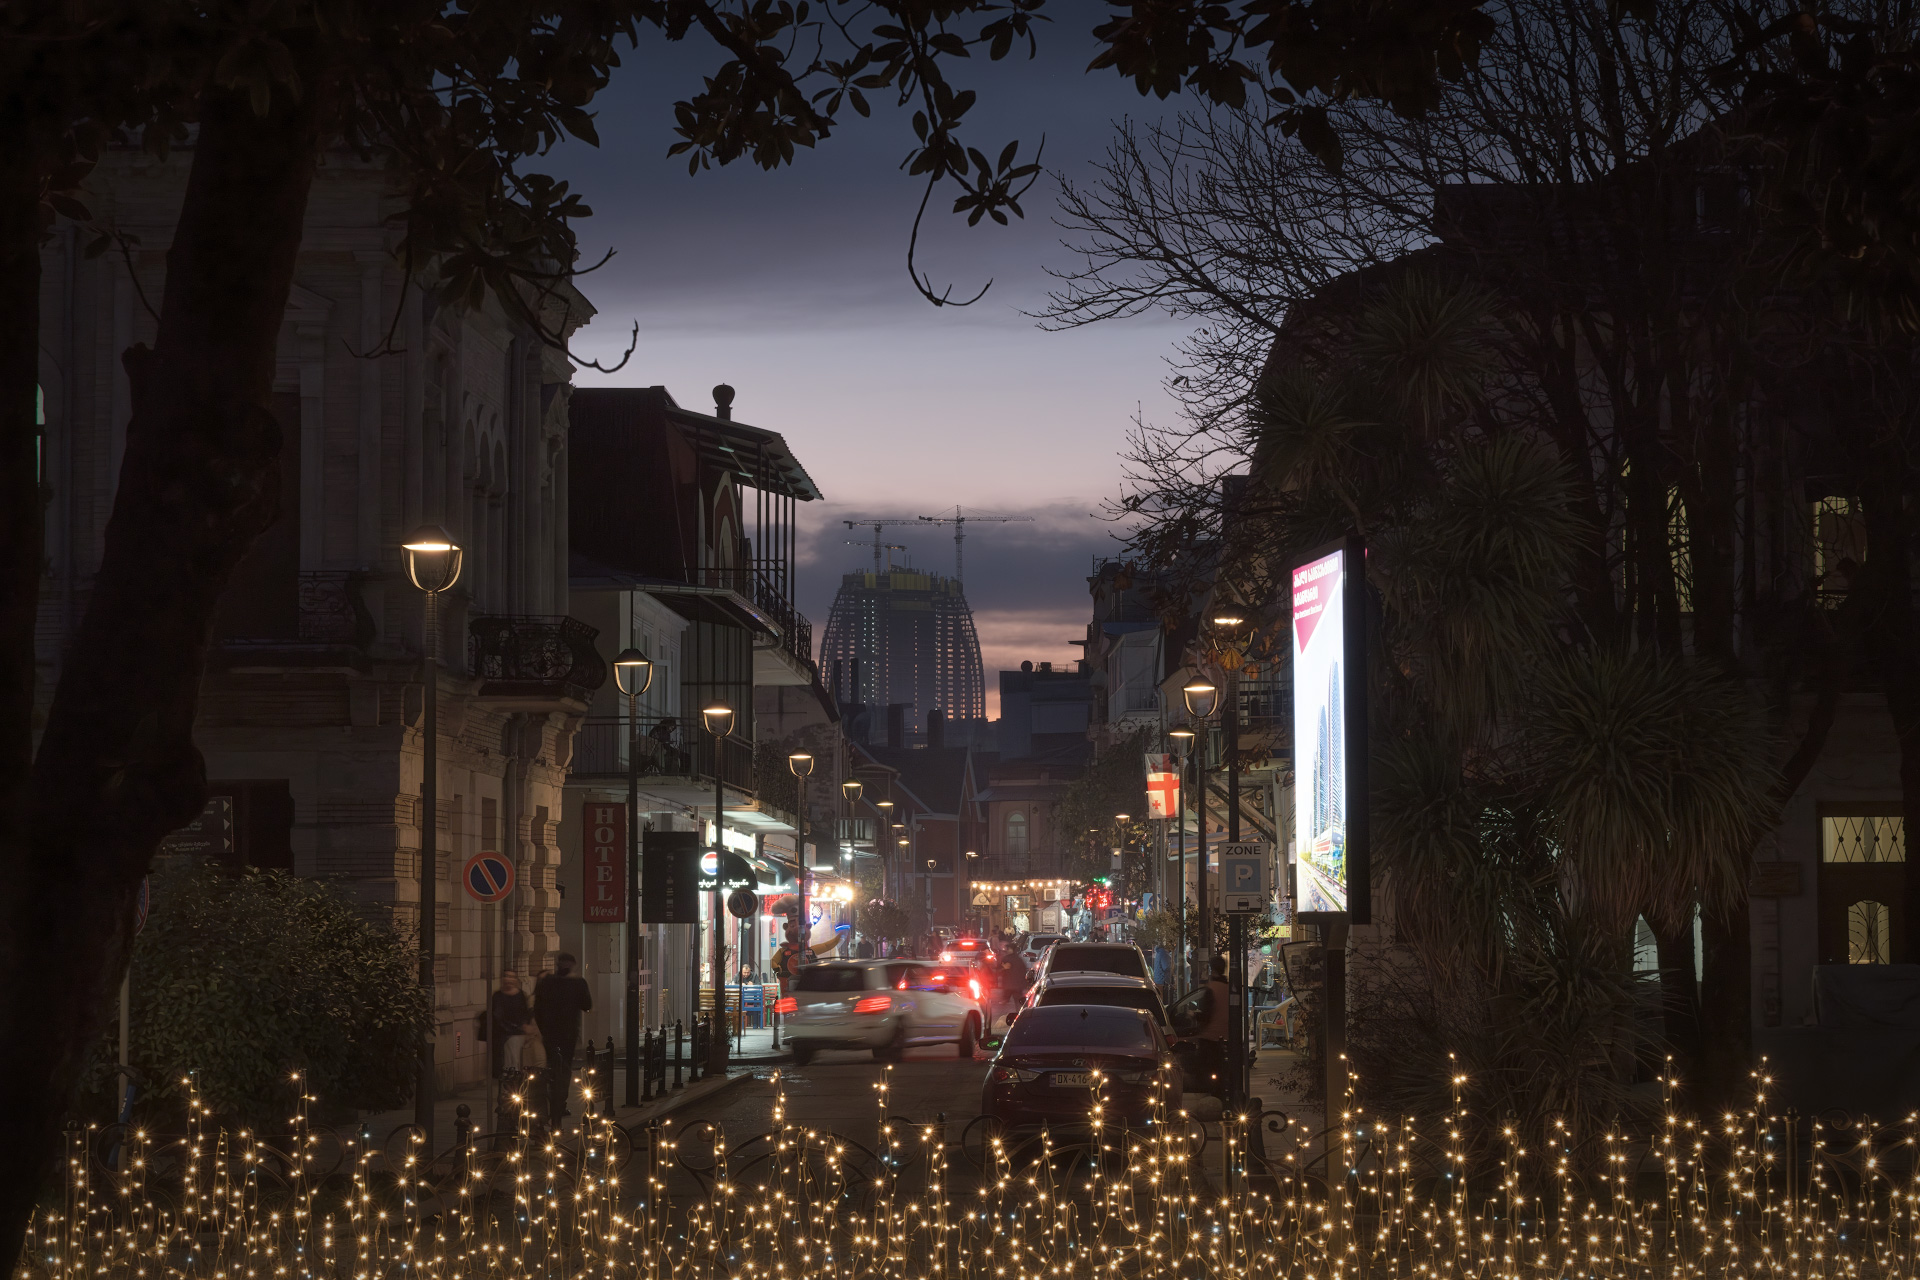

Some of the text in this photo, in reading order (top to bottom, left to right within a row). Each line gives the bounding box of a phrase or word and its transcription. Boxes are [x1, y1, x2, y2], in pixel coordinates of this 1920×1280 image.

[594, 807, 615, 901] HOTEL
[1226, 845, 1262, 856] ZONE
[1235, 864, 1253, 888] P
[590, 905, 619, 917] West
